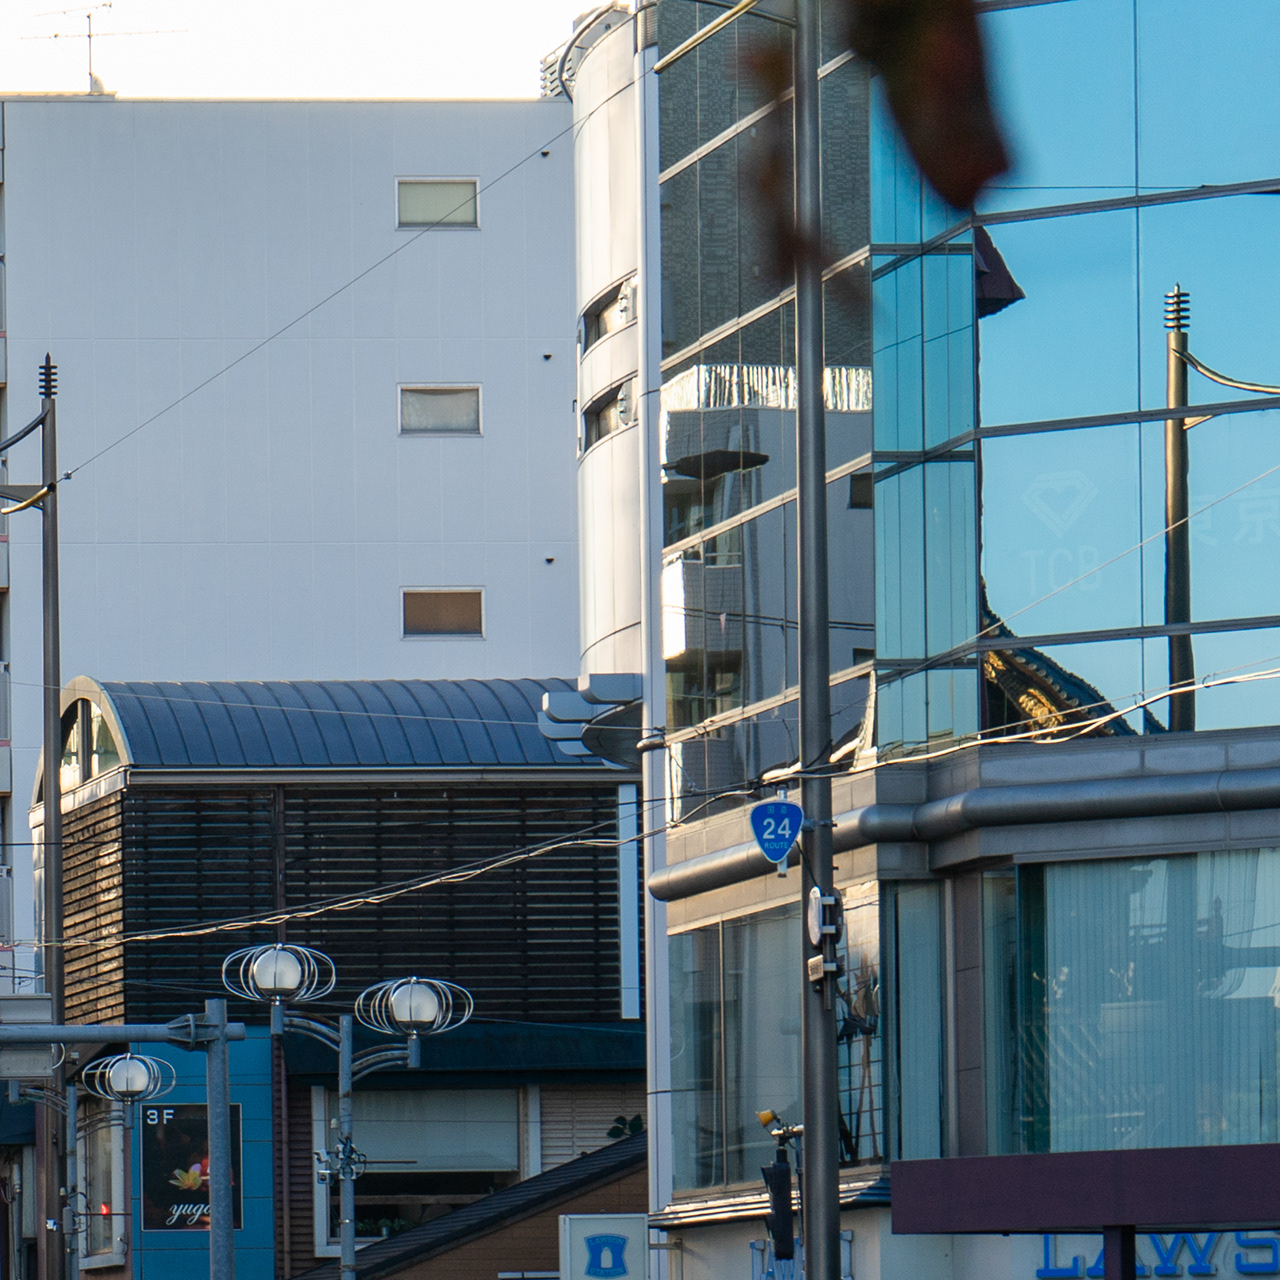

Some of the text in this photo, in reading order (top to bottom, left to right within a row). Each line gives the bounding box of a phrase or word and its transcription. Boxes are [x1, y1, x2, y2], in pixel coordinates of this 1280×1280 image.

[763, 818, 792, 839] 24
[764, 841, 789, 849] ROUTE
[146, 1109, 175, 1125] 3F
